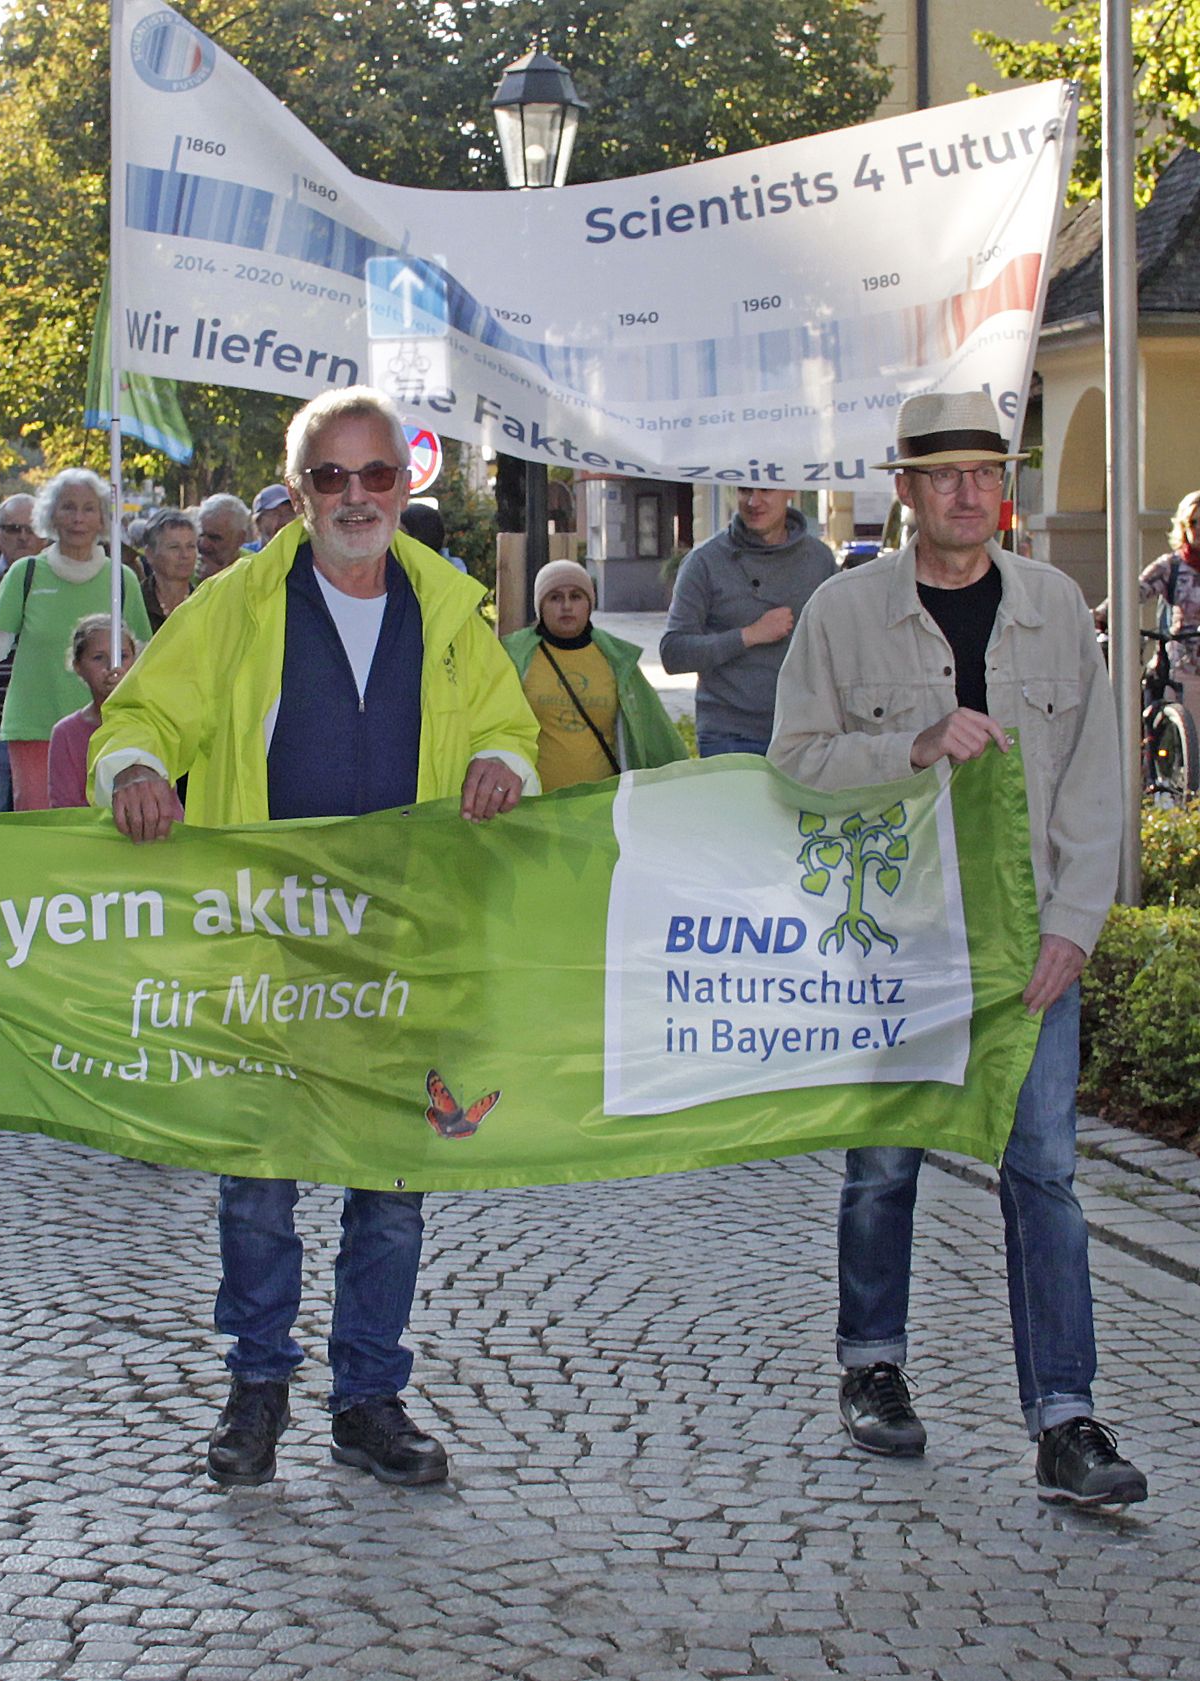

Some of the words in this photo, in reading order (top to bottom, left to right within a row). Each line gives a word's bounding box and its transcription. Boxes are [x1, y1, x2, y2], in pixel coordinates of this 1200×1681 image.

[185, 136, 226, 156] 1860
[302, 177, 338, 202] 1880
[585, 171, 839, 244] Scientists
[853, 153, 885, 192] 4
[861, 272, 901, 292] 1980
[494, 308, 532, 325] 1920
[618, 311, 660, 326] 1940
[742, 295, 782, 313] 1960
[173, 254, 217, 274] 2014
[234, 263, 284, 287] 2020
[289, 278, 353, 305] waren
[473, 350, 532, 389] sieben
[634, 412, 693, 433] Jahre
[697, 409, 737, 426] seit
[125, 308, 180, 355] Wir
[192, 317, 360, 388] liefern
[678, 458, 786, 484] Zeit
[803, 459, 866, 482] zu
[193, 867, 372, 937] aktiv
[665, 916, 807, 954] BUND
[131, 977, 207, 1038] für
[221, 969, 410, 1026] Mensch
[666, 969, 906, 1005] Naturschutz
[666, 1017, 698, 1053] in
[711, 1018, 840, 1063] Bayern
[851, 1017, 907, 1050] e.V.
